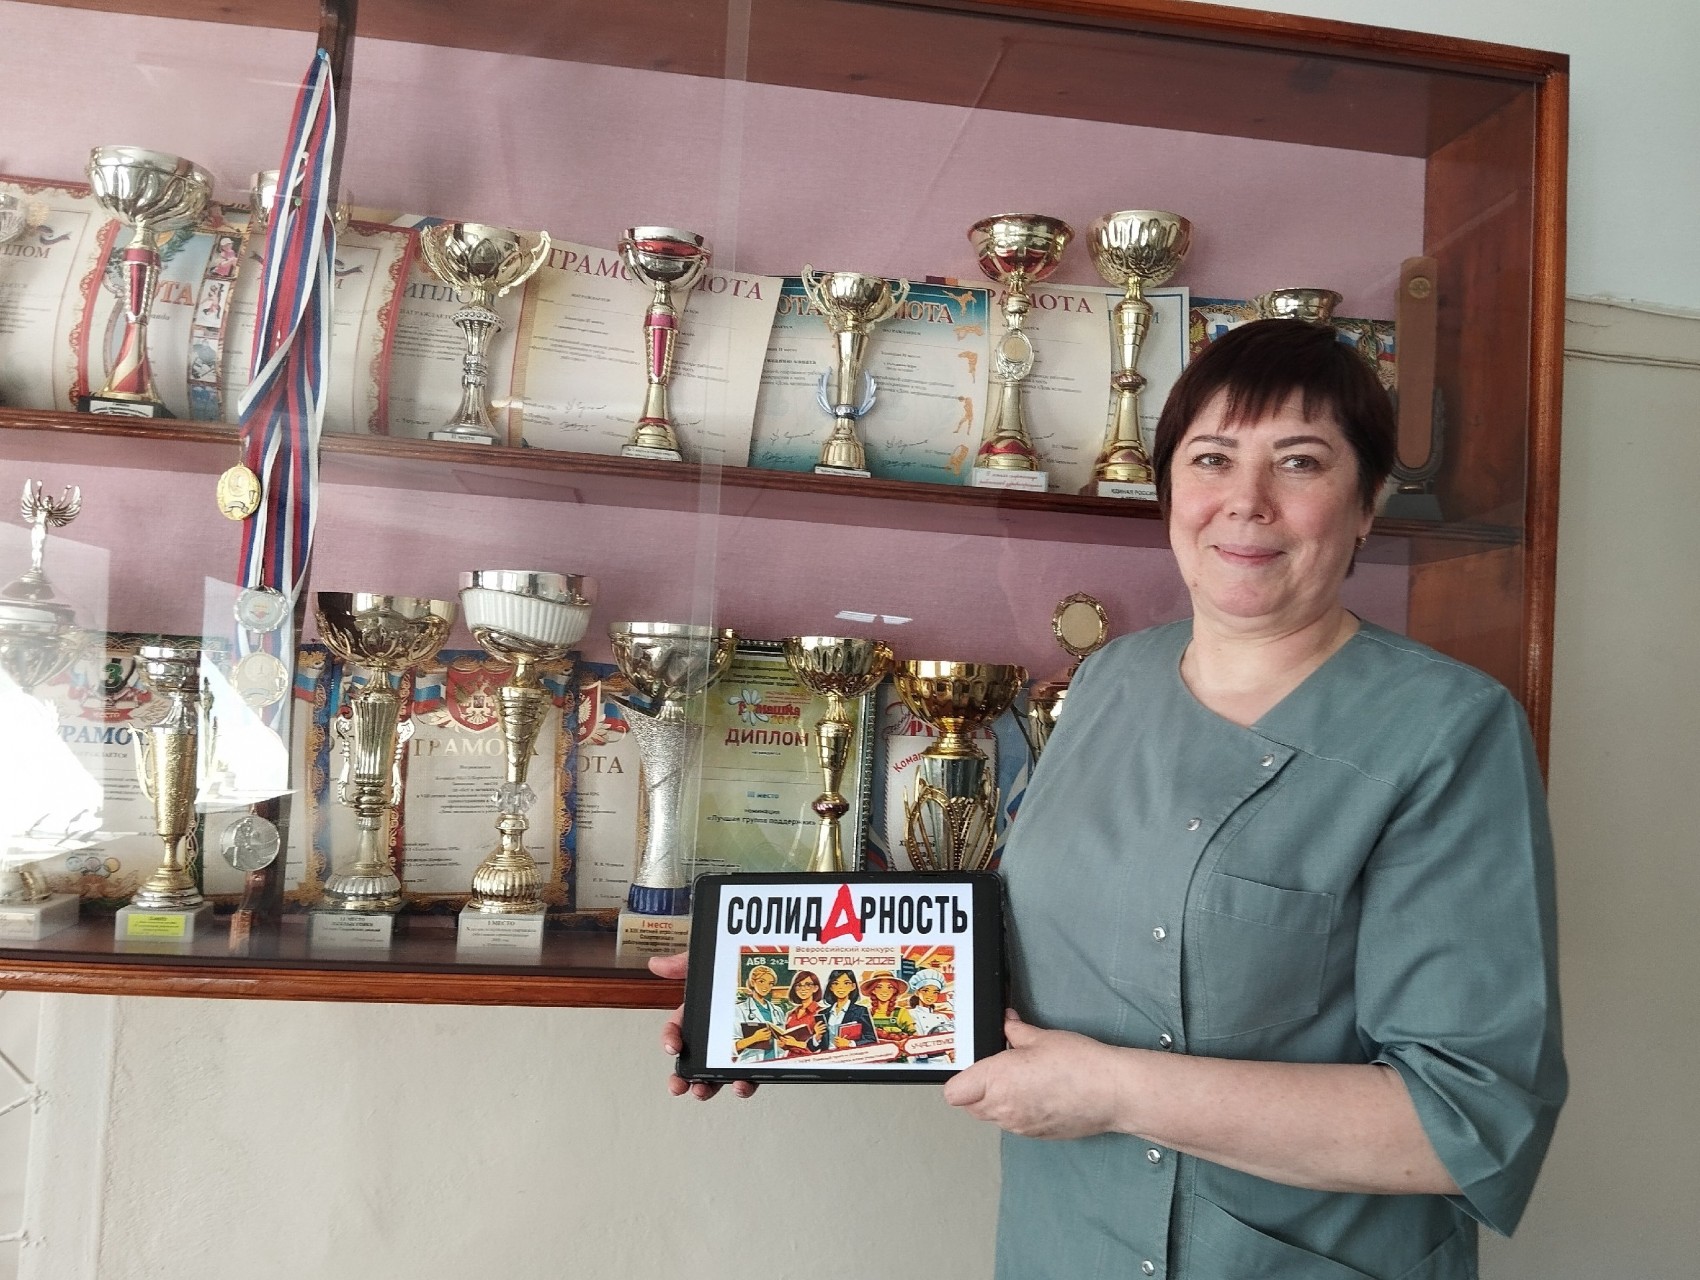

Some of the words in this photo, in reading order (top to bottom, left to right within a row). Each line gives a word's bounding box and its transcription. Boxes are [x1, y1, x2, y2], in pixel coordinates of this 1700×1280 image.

[988, 288, 1094, 314] РОТА
[725, 728, 809, 747] ДИПЛОМ
[414, 738, 539, 757] ГРАМО
[727, 883, 968, 944] СОЛИДАРНОСТЬ
[796, 946, 859, 954] Всероссийский
[862, 946, 895, 955] конкурс
[747, 957, 766, 966] АБВ
